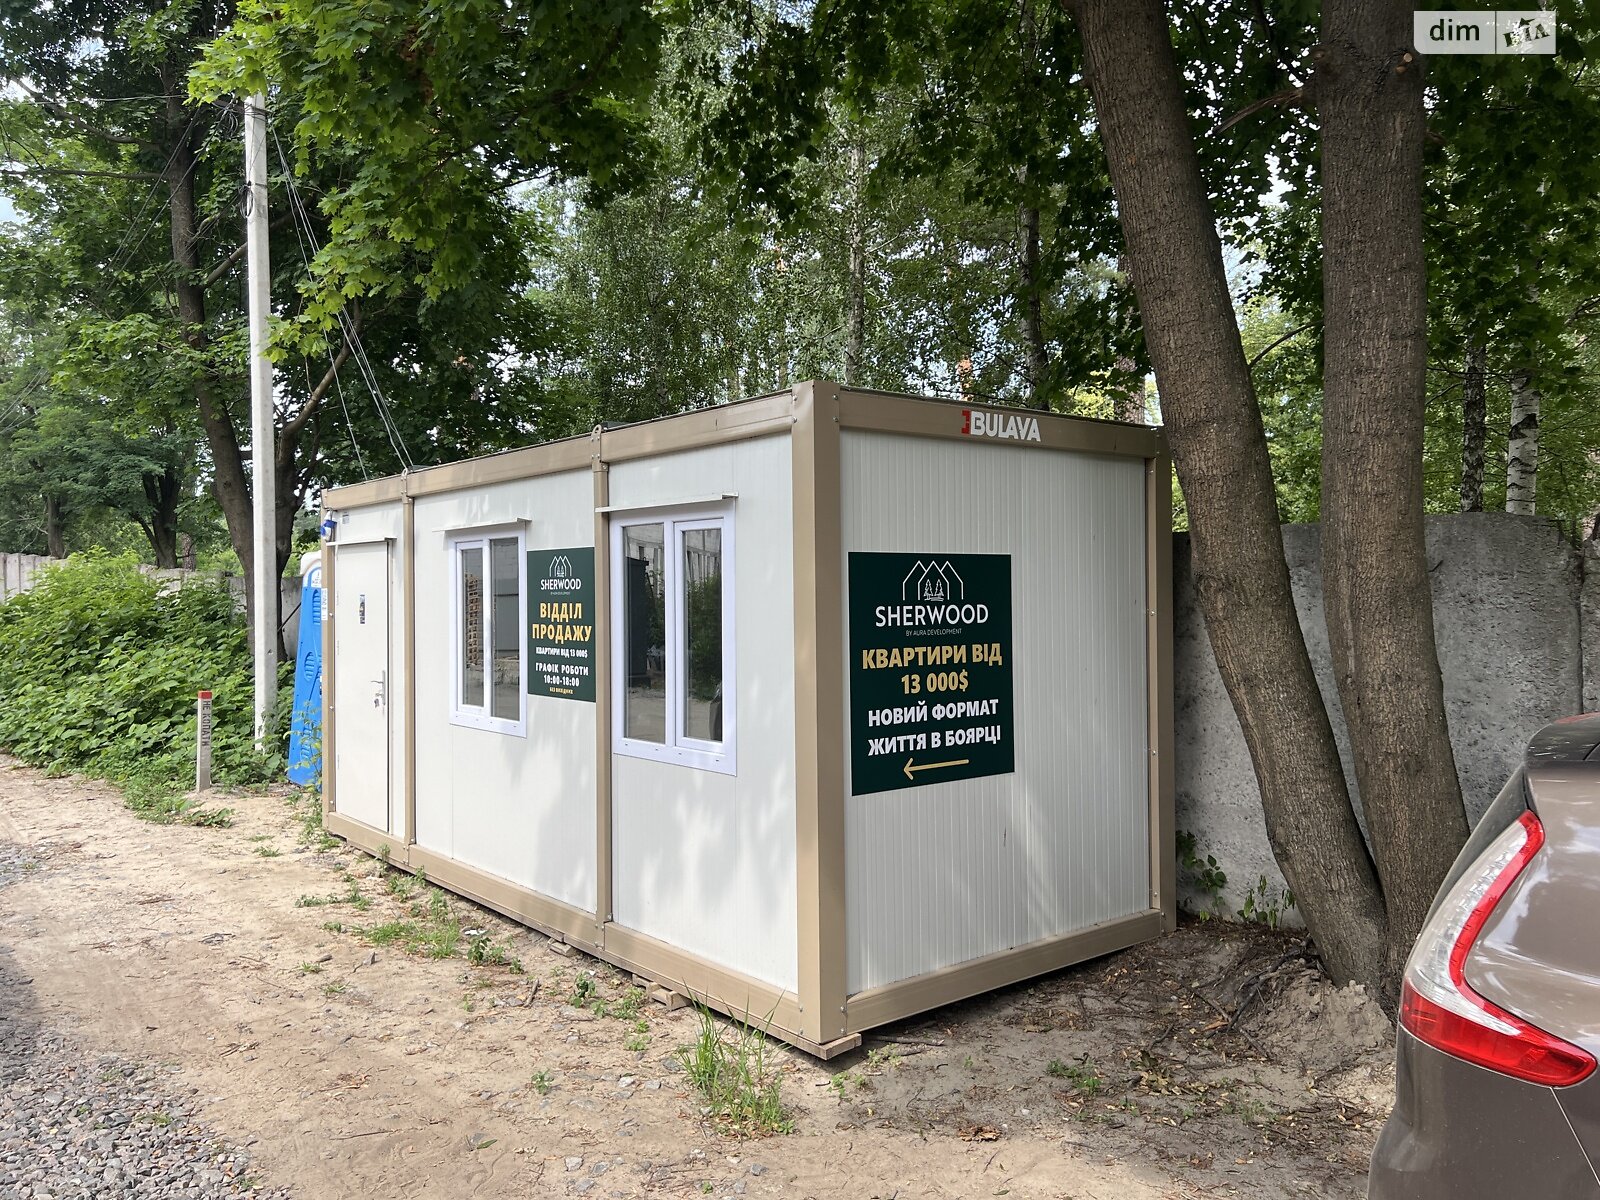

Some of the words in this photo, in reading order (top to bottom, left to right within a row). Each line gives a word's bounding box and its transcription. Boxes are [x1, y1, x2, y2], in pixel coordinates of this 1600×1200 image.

[970, 411, 1041, 441] BULAVA
[540, 578, 582, 591] SHERWOOD
[540, 603, 582, 622] ВІДДІЛ
[875, 604, 989, 627] SHERWOOD
[532, 624, 592, 644] ПРОДАЖУ
[927, 628, 962, 636] DEVELOPMENT
[535, 646, 560, 656] КВАРТИРИ
[862, 644, 967, 670] КВАРТИРИ
[972, 642, 1003, 666] ВІД
[535, 662, 559, 674] ГРАФІК
[561, 664, 589, 676] РОБОТИ
[543, 674, 580, 687] 10:00-18:00
[901, 674, 921, 695] 13
[926, 669, 969, 692] 000$
[202, 701, 211, 710] НЕ
[868, 700, 928, 727] НОВИЙ
[931, 698, 999, 721] ФОРМАТ
[867, 733, 927, 756] ЖИТТЯ
[931, 732, 942, 749] В
[945, 725, 1001, 747] БОЯРЦІ
